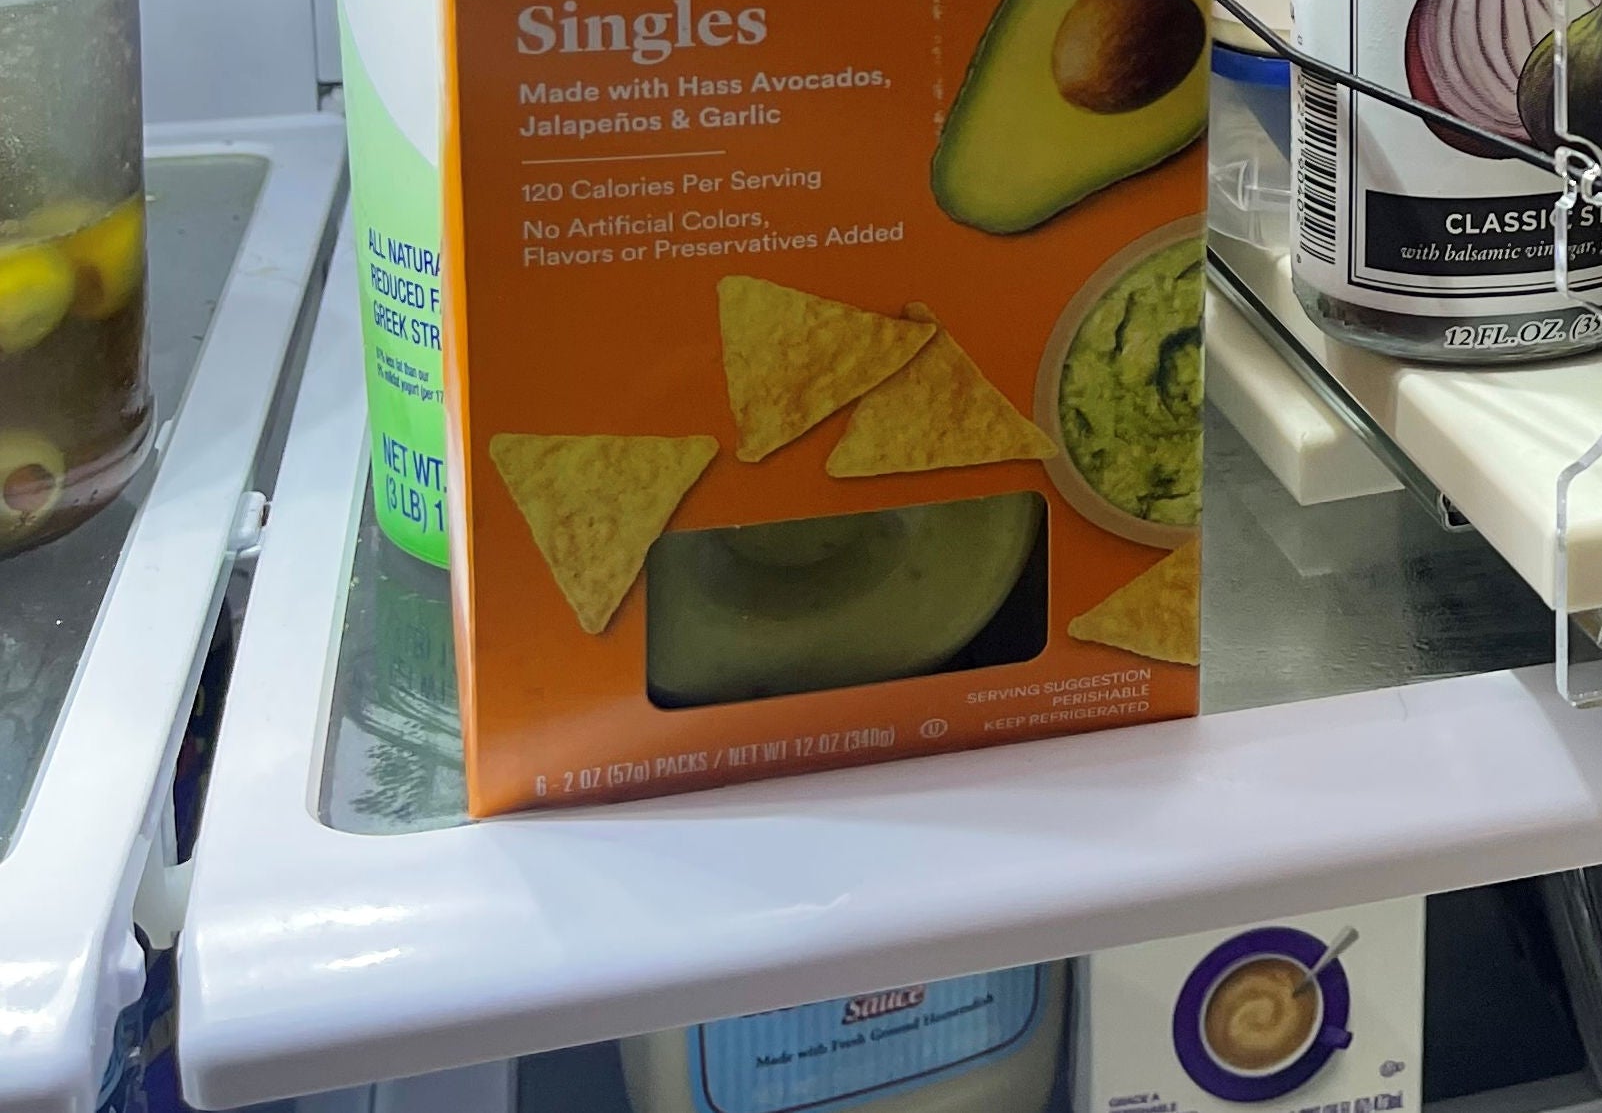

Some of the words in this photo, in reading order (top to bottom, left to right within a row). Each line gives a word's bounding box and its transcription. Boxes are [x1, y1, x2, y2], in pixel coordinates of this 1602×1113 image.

[520, 83, 600, 105] Made
[608, 77, 670, 101] with
[679, 75, 743, 98] Hass
[751, 67, 892, 94] Avocados,
[520, 109, 662, 139] Jalapeños
[671, 108, 690, 130] &
[700, 104, 782, 127] Garlic
[522, 183, 563, 202] 120
[571, 176, 675, 199] Calories
[683, 173, 723, 193] Per
[731, 168, 822, 192] Serving
[523, 219, 560, 240] No
[568, 213, 675, 238] Artificial
[681, 207, 770, 232] Colors,
[369, 227, 386, 259] ALL
[524, 244, 614, 267] Flavors
[622, 245, 647, 262] or
[654, 231, 818, 261] Preservatives
[826, 222, 904, 247] Added
[1400, 243, 1440, 261] with
[1444, 242, 1522, 263] balsamic
[1525, 239, 1598, 263] vingar,
[370, 263, 425, 309] REDUCED
[373, 300, 409, 340] GREEK
[1446, 327, 1473, 348] 12
[383, 432, 408, 477] NET
[412, 450, 447, 494] WT.
[386, 473, 398, 513] (3
[400, 483, 428, 534] LB)
[966, 686, 1041, 704] SERVING
[1043, 668, 1151, 693] SUGGESTION
[1052, 683, 1150, 707] PERISHABLE
[984, 715, 1027, 732] KEEP
[1029, 700, 1150, 725] REFRIGERATED
[563, 771, 573, 793] 2
[580, 767, 601, 791] OZ
[655, 751, 708, 778] PACKS
[728, 743, 758, 767] NET
[762, 740, 788, 761] WT
[795, 735, 813, 757] 12
[819, 732, 840, 754] OZ
[845, 725, 896, 752] (340g)
[845, 985, 926, 1023] Sauce
